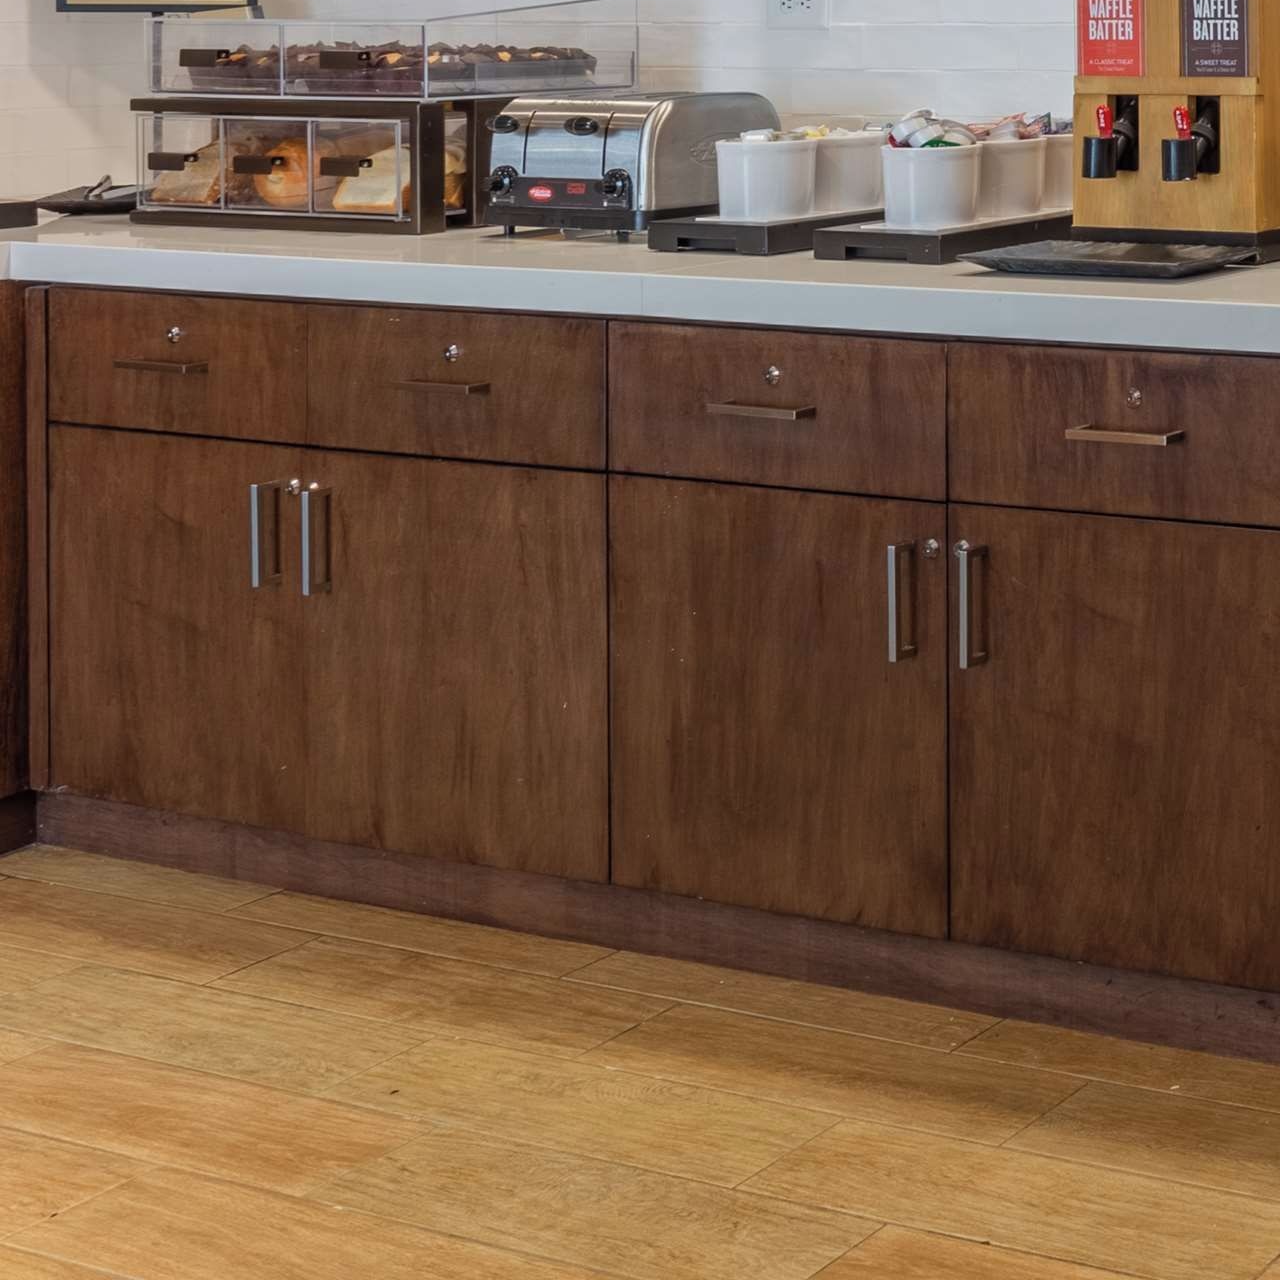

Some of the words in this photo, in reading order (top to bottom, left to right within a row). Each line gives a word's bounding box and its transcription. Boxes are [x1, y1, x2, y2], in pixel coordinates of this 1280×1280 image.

[1088, 19, 1134, 41] BATTER
[1193, 19, 1239, 41] BATTER
[1200, 58, 1219, 66] SWEET
[1220, 58, 1237, 66] TREAT
